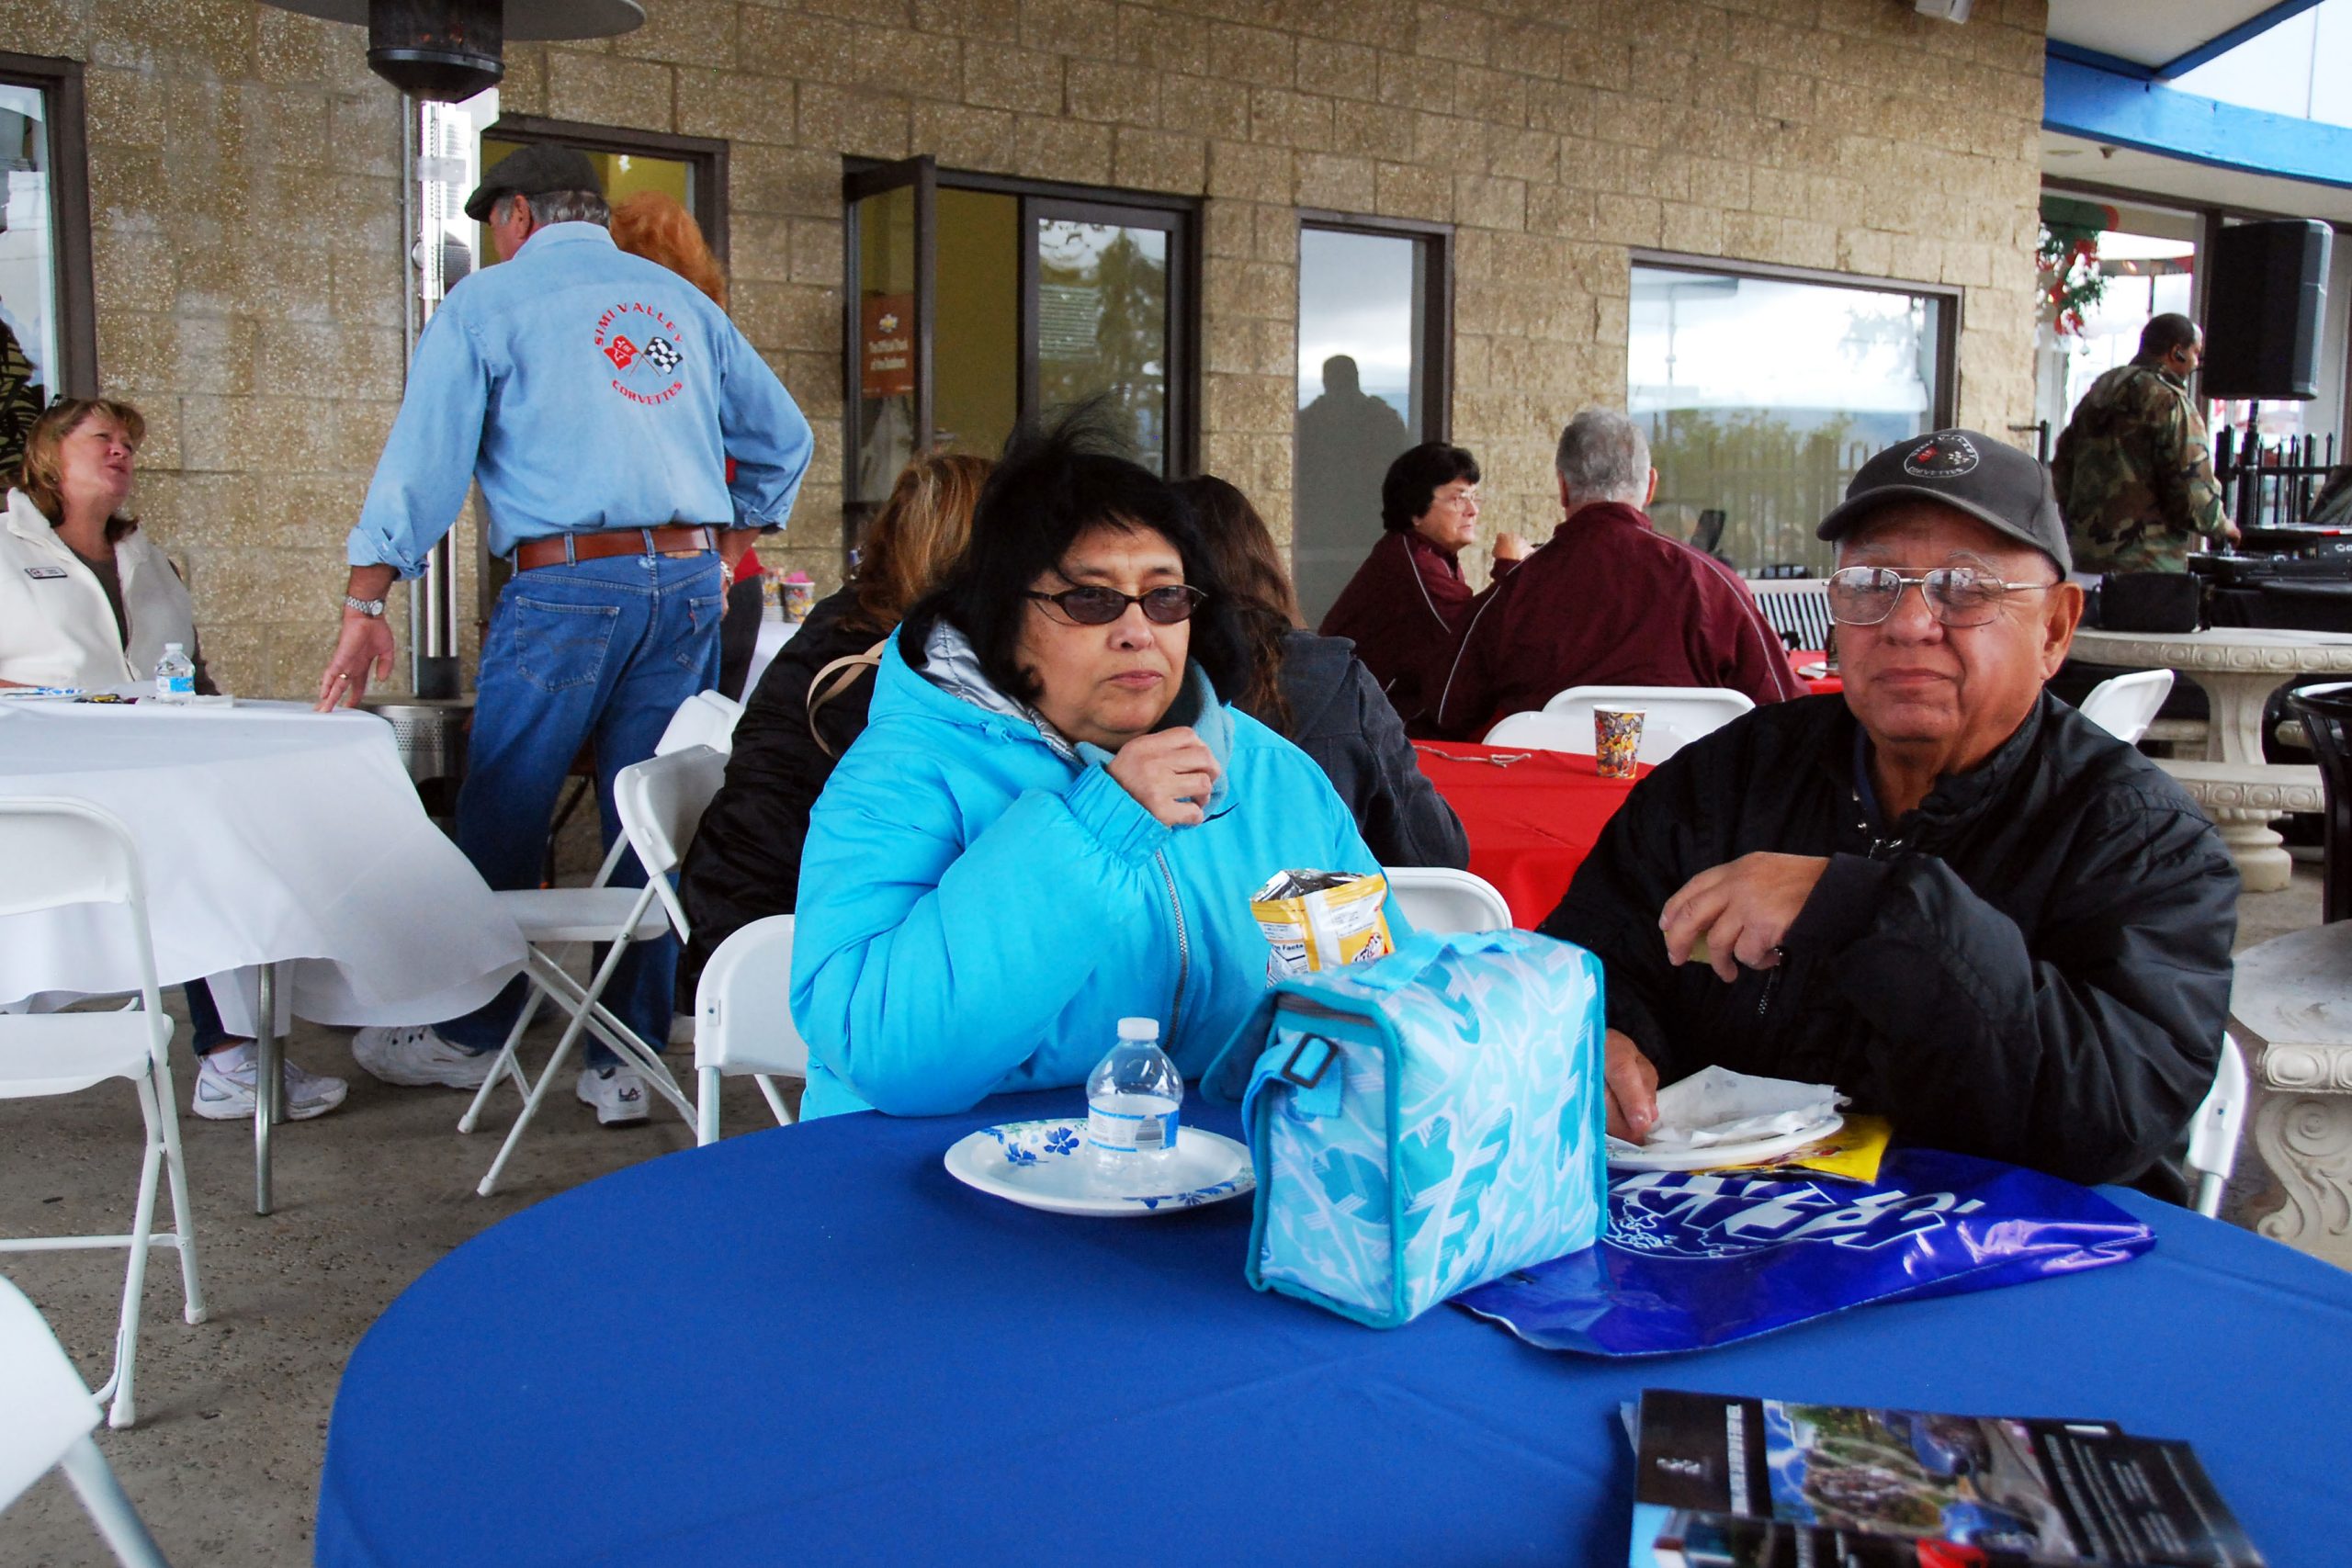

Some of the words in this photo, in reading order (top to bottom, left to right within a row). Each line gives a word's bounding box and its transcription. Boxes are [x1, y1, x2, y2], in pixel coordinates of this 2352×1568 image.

[594, 309, 616, 346] SIMI
[616, 301, 683, 343] VALLEY
[612, 379, 683, 405] CORVETTES
